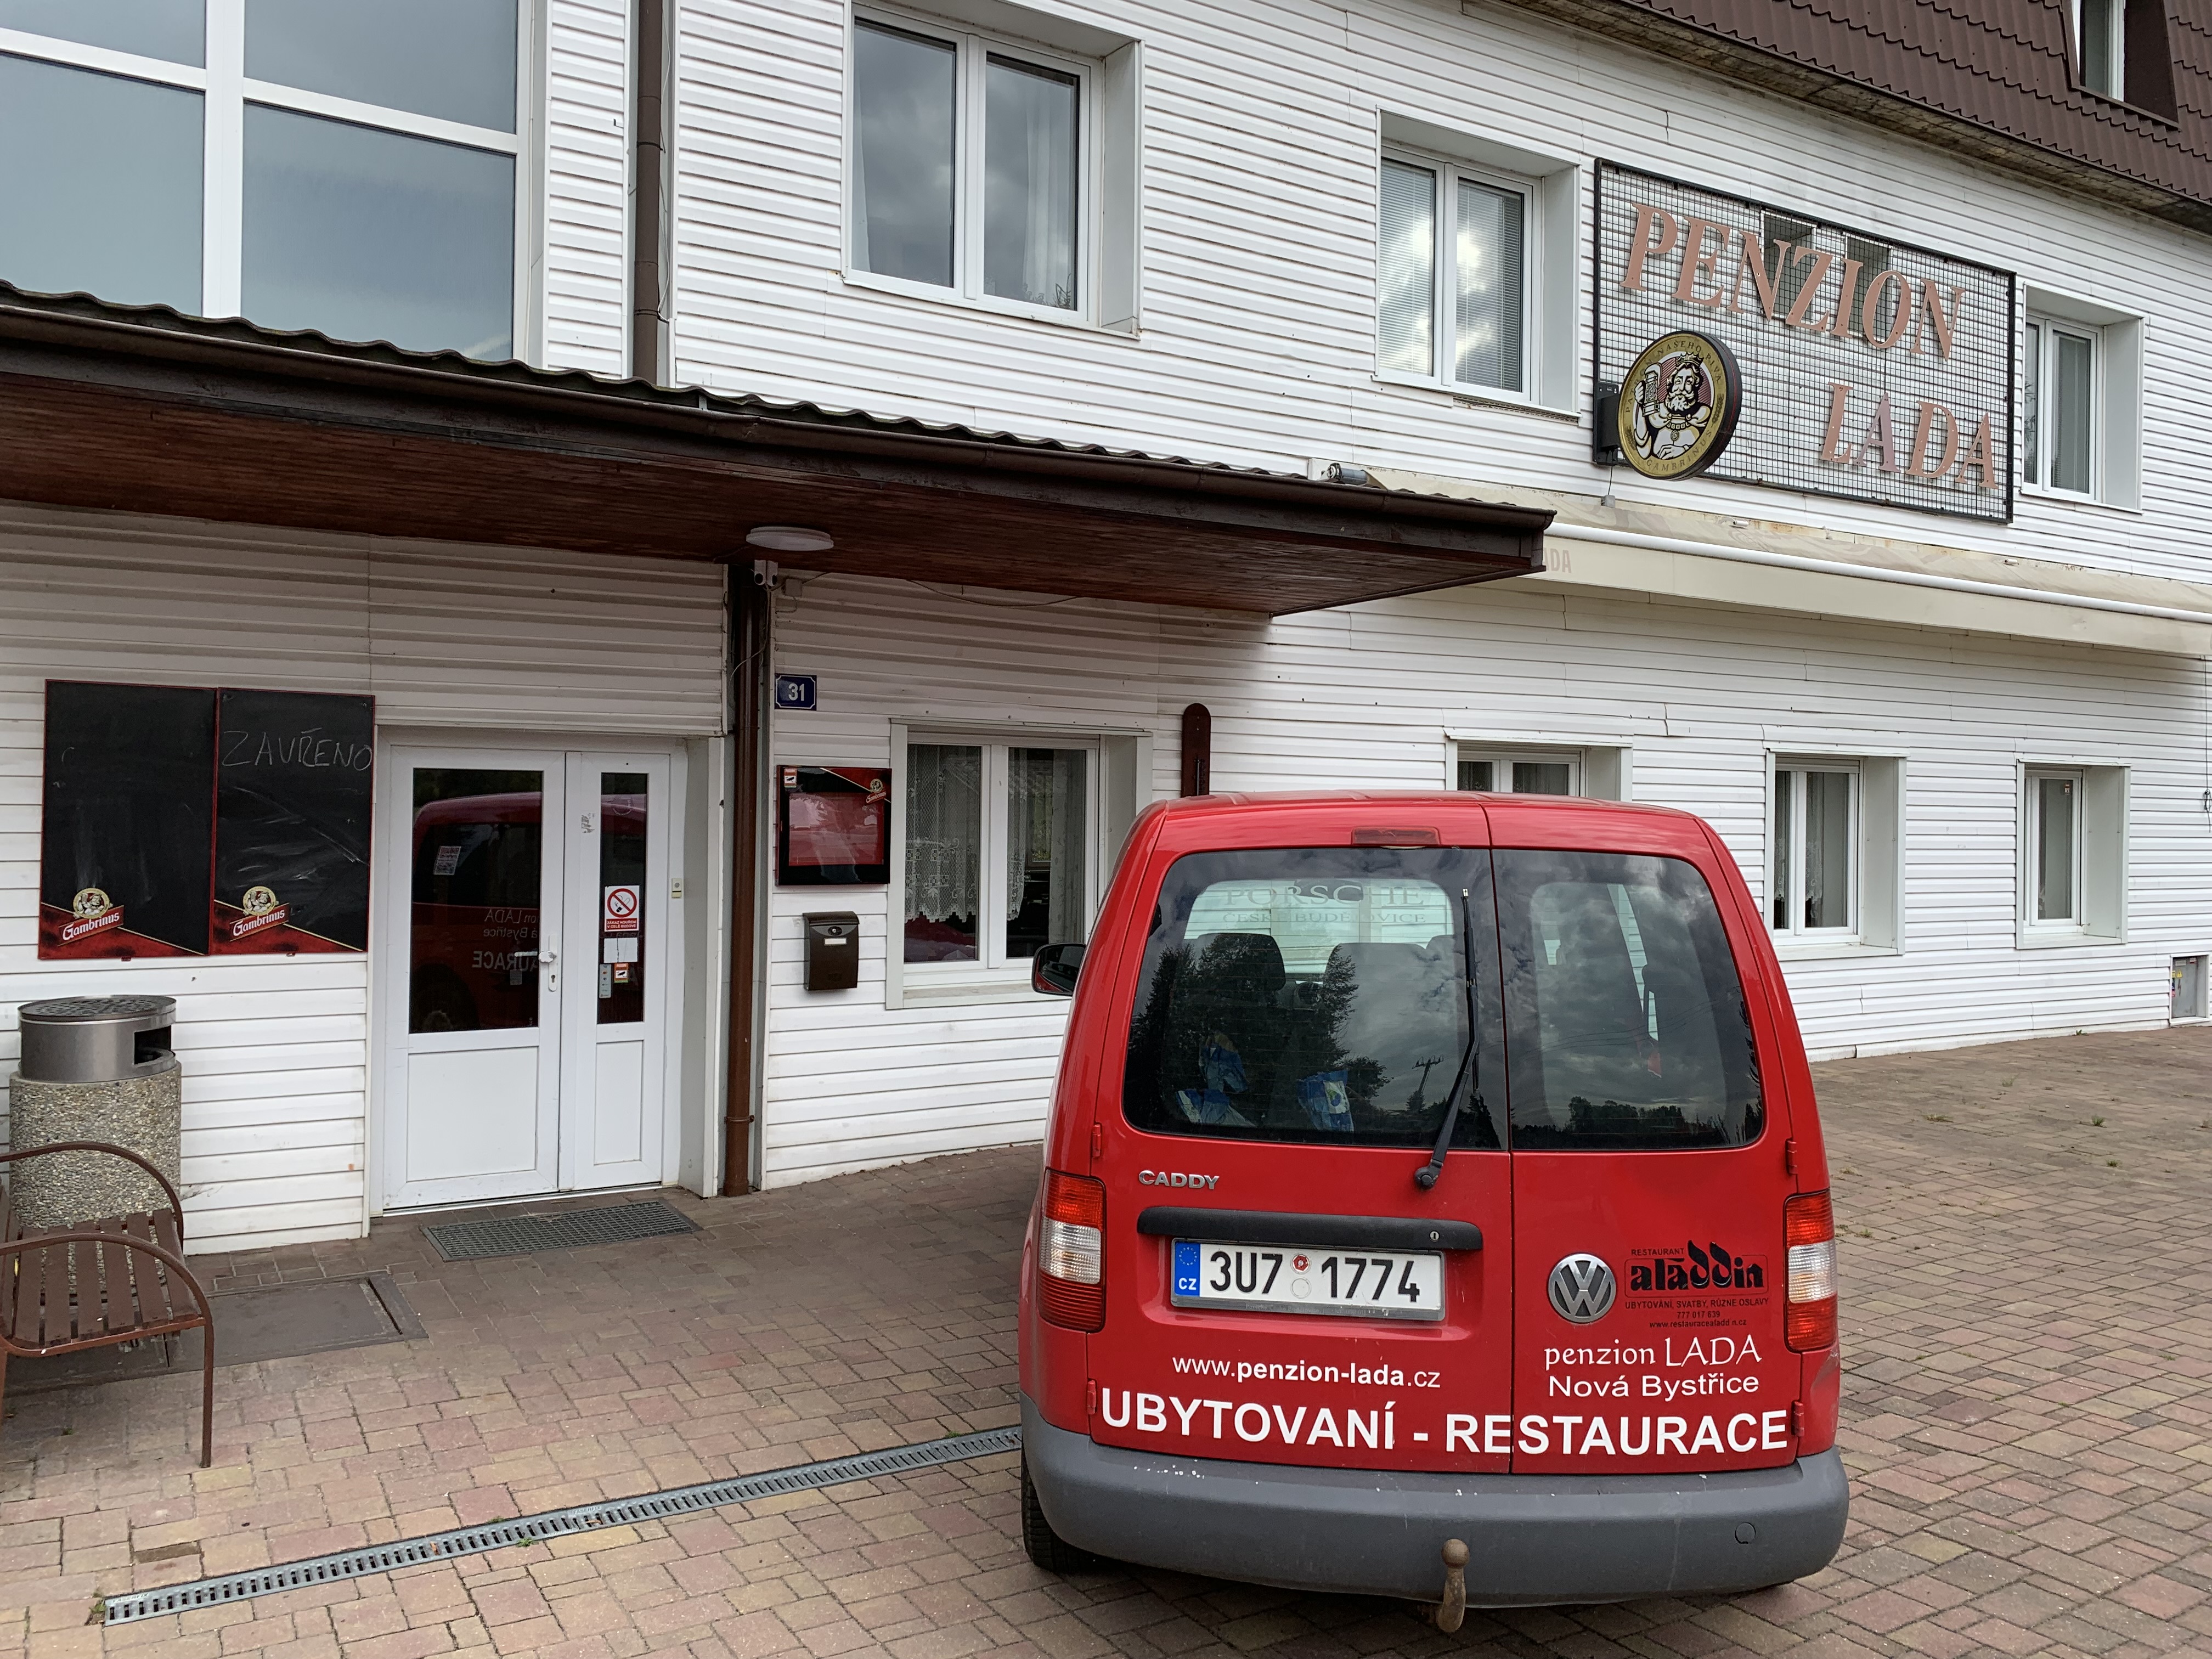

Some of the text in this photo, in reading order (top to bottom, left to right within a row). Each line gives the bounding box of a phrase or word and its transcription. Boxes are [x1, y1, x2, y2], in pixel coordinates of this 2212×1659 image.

[1620, 202, 1966, 362] PENZION
[1705, 353, 1722, 383] PIVA
[1820, 381, 2000, 490] LADA
[1646, 430, 1712, 471] GAMBRINUS
[1542, 548, 1572, 573] ADA
[788, 683, 804, 701] 31
[1224, 885, 1424, 905] PORSCHE
[62, 912, 120, 940] Gambrinus
[233, 909, 285, 936] Gambrinus
[1138, 1170, 1220, 1190] CADDY
[1630, 1248, 1685, 1256] RESTAURANT
[1178, 1251, 1420, 1302] CZ 3U7 1774
[1676, 1298, 1708, 1309] SVATBY,
[1739, 1297, 1769, 1306] OSLAVY
[1544, 1334, 1762, 1370] penzion LADA
[1172, 1357, 1441, 1388] www.penzion-lada.cz
[1549, 1373, 1759, 1402] Nová Bystřice
[1102, 1387, 1396, 1449] UBYTOVANÍ
[1446, 1409, 1787, 1455] RESTAURACE
